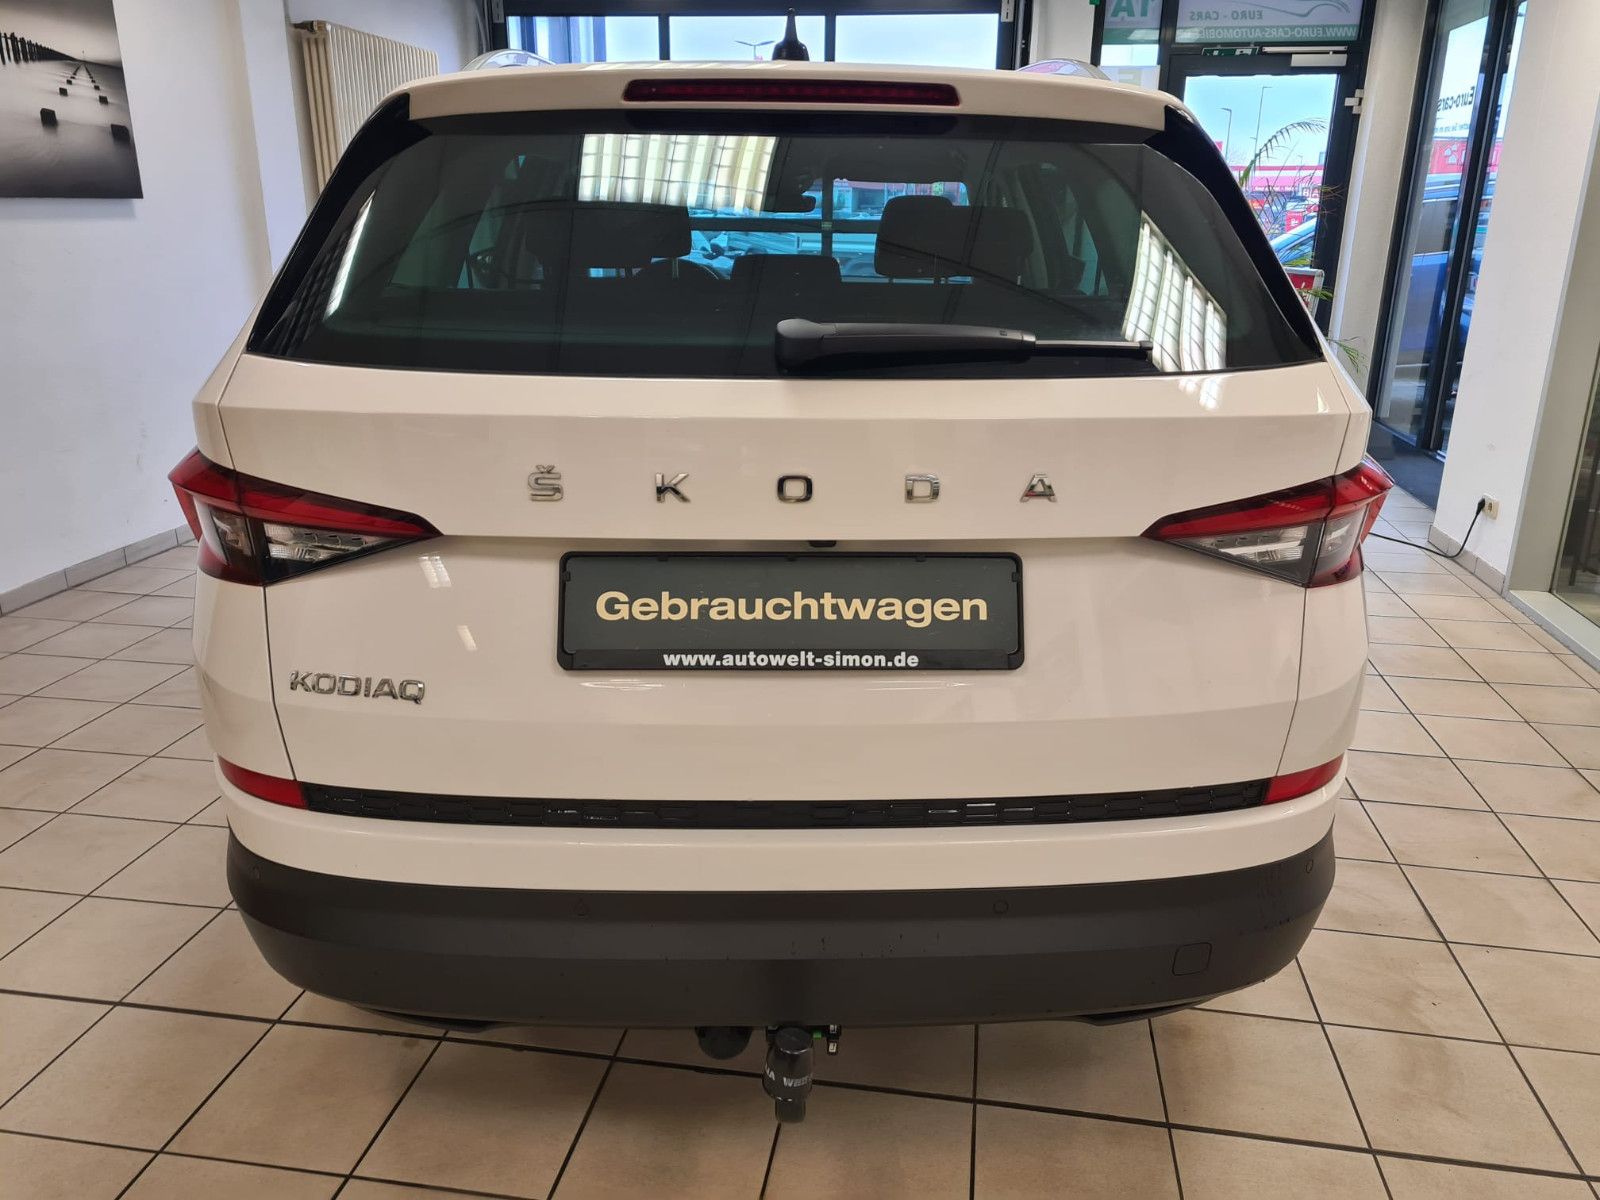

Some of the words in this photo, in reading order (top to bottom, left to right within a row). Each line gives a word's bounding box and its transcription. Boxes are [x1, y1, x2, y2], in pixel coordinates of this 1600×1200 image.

[528, 464, 1057, 503] ŠKODA
[595, 590, 988, 628] Gebrauchtwagen
[663, 651, 920, 668] www.autowelt-simon.de
[290, 670, 426, 705] KODIAQ
